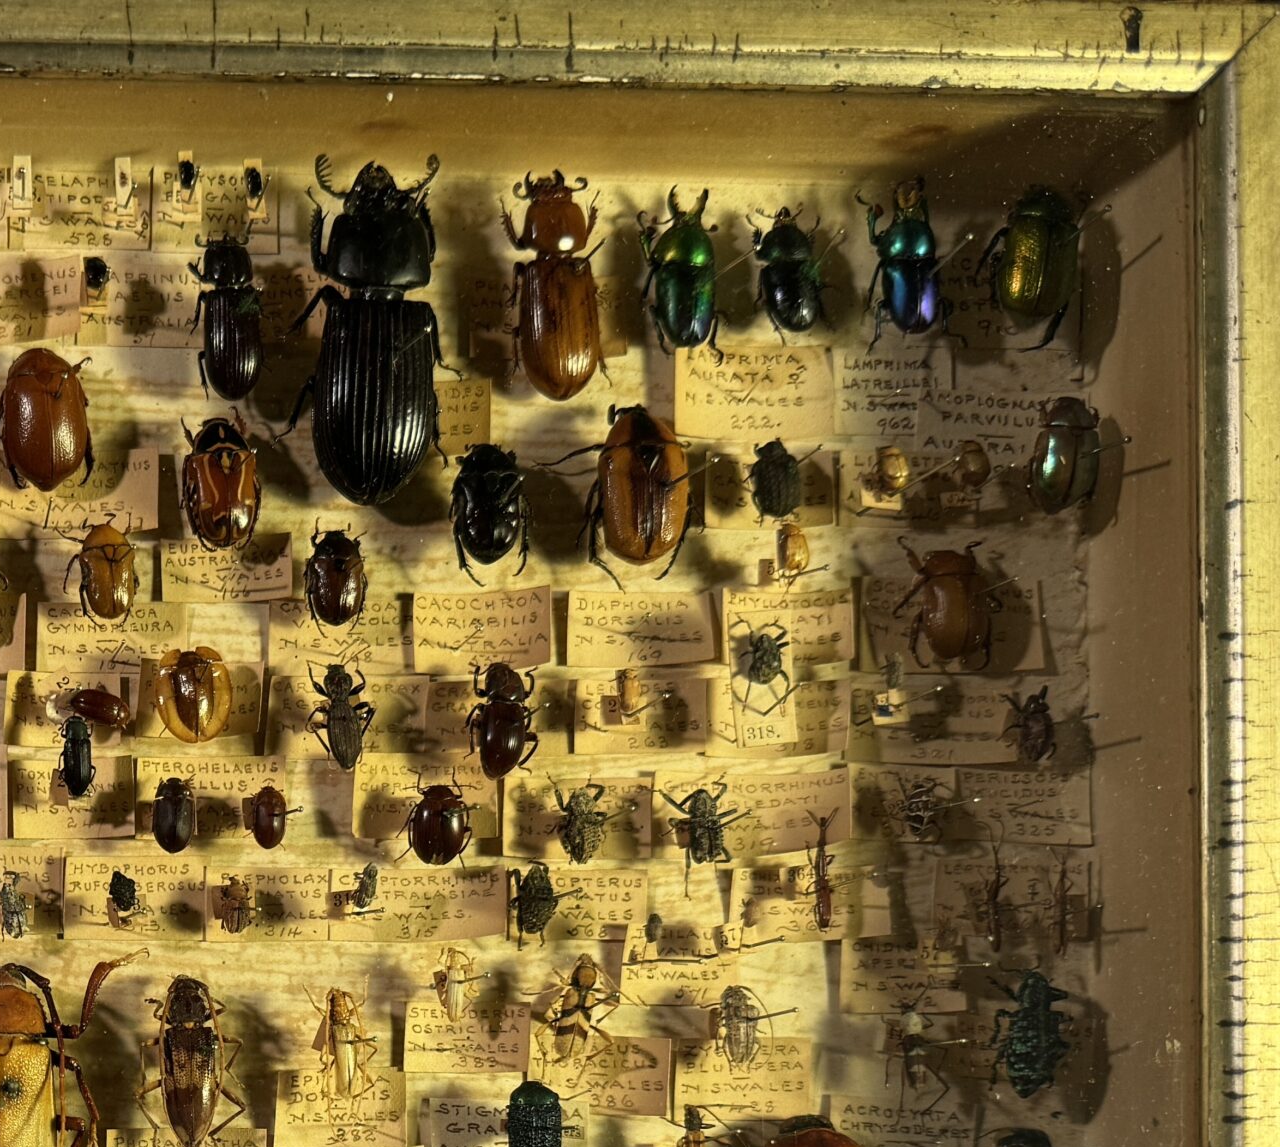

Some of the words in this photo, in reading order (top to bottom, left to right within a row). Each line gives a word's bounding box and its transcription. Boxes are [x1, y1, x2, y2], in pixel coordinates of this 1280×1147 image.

[578, 598, 689, 611] DIAPHONIA
[416, 612, 537, 627] VARIABILIS
[747, 727, 781, 741] 318.
[412, 1022, 519, 1034] OSTRICILLA
